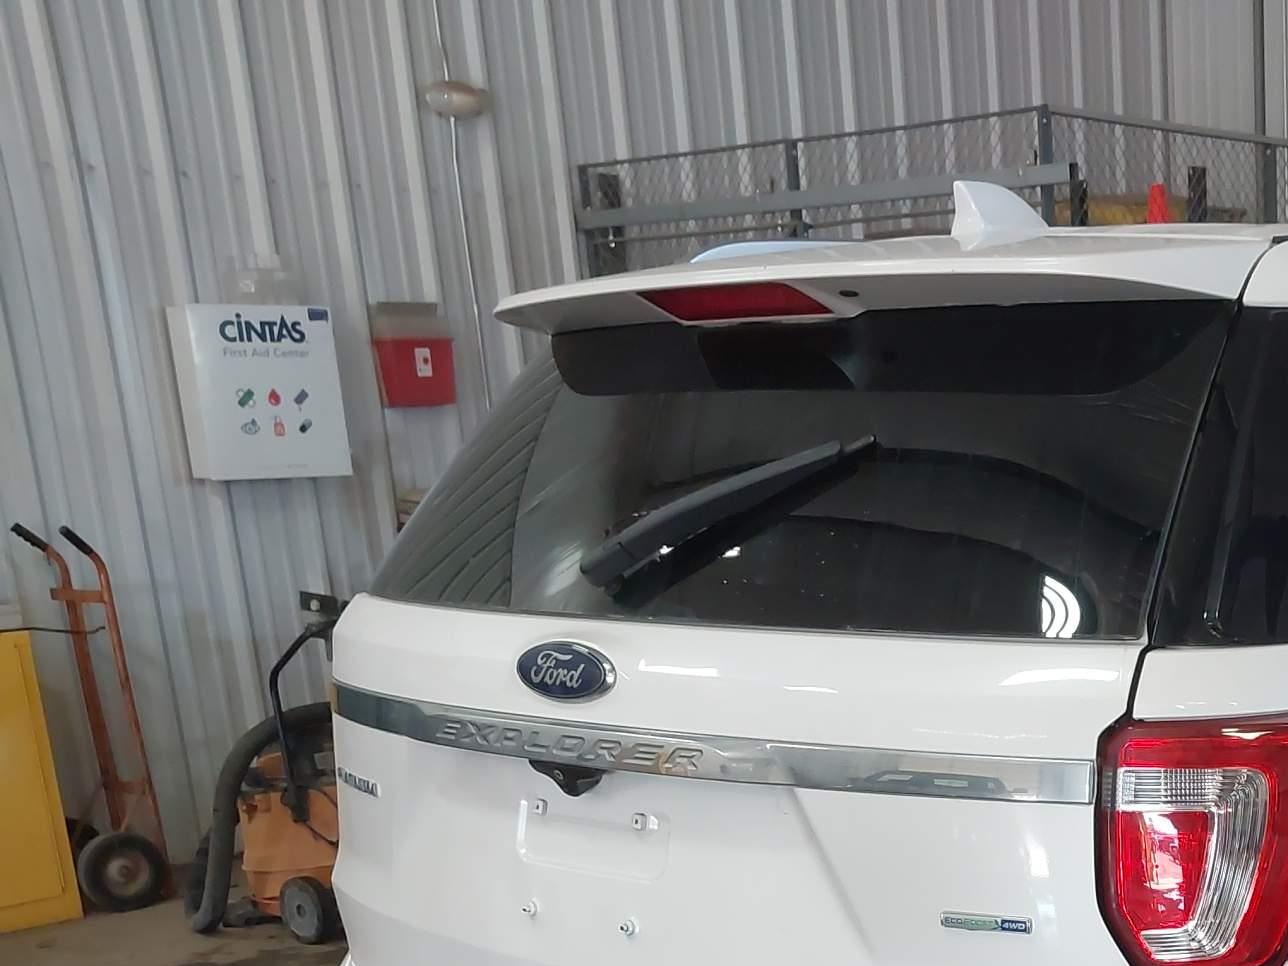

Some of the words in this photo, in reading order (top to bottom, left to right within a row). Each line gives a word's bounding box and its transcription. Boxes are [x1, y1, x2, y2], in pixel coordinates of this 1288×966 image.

[223, 348, 248, 358] First
[251, 348, 270, 358] Aid
[274, 348, 310, 358] Center
[530, 649, 586, 689] Ford
[435, 720, 704, 771] EXPLORER
[1002, 920, 1026, 931] 4WD
